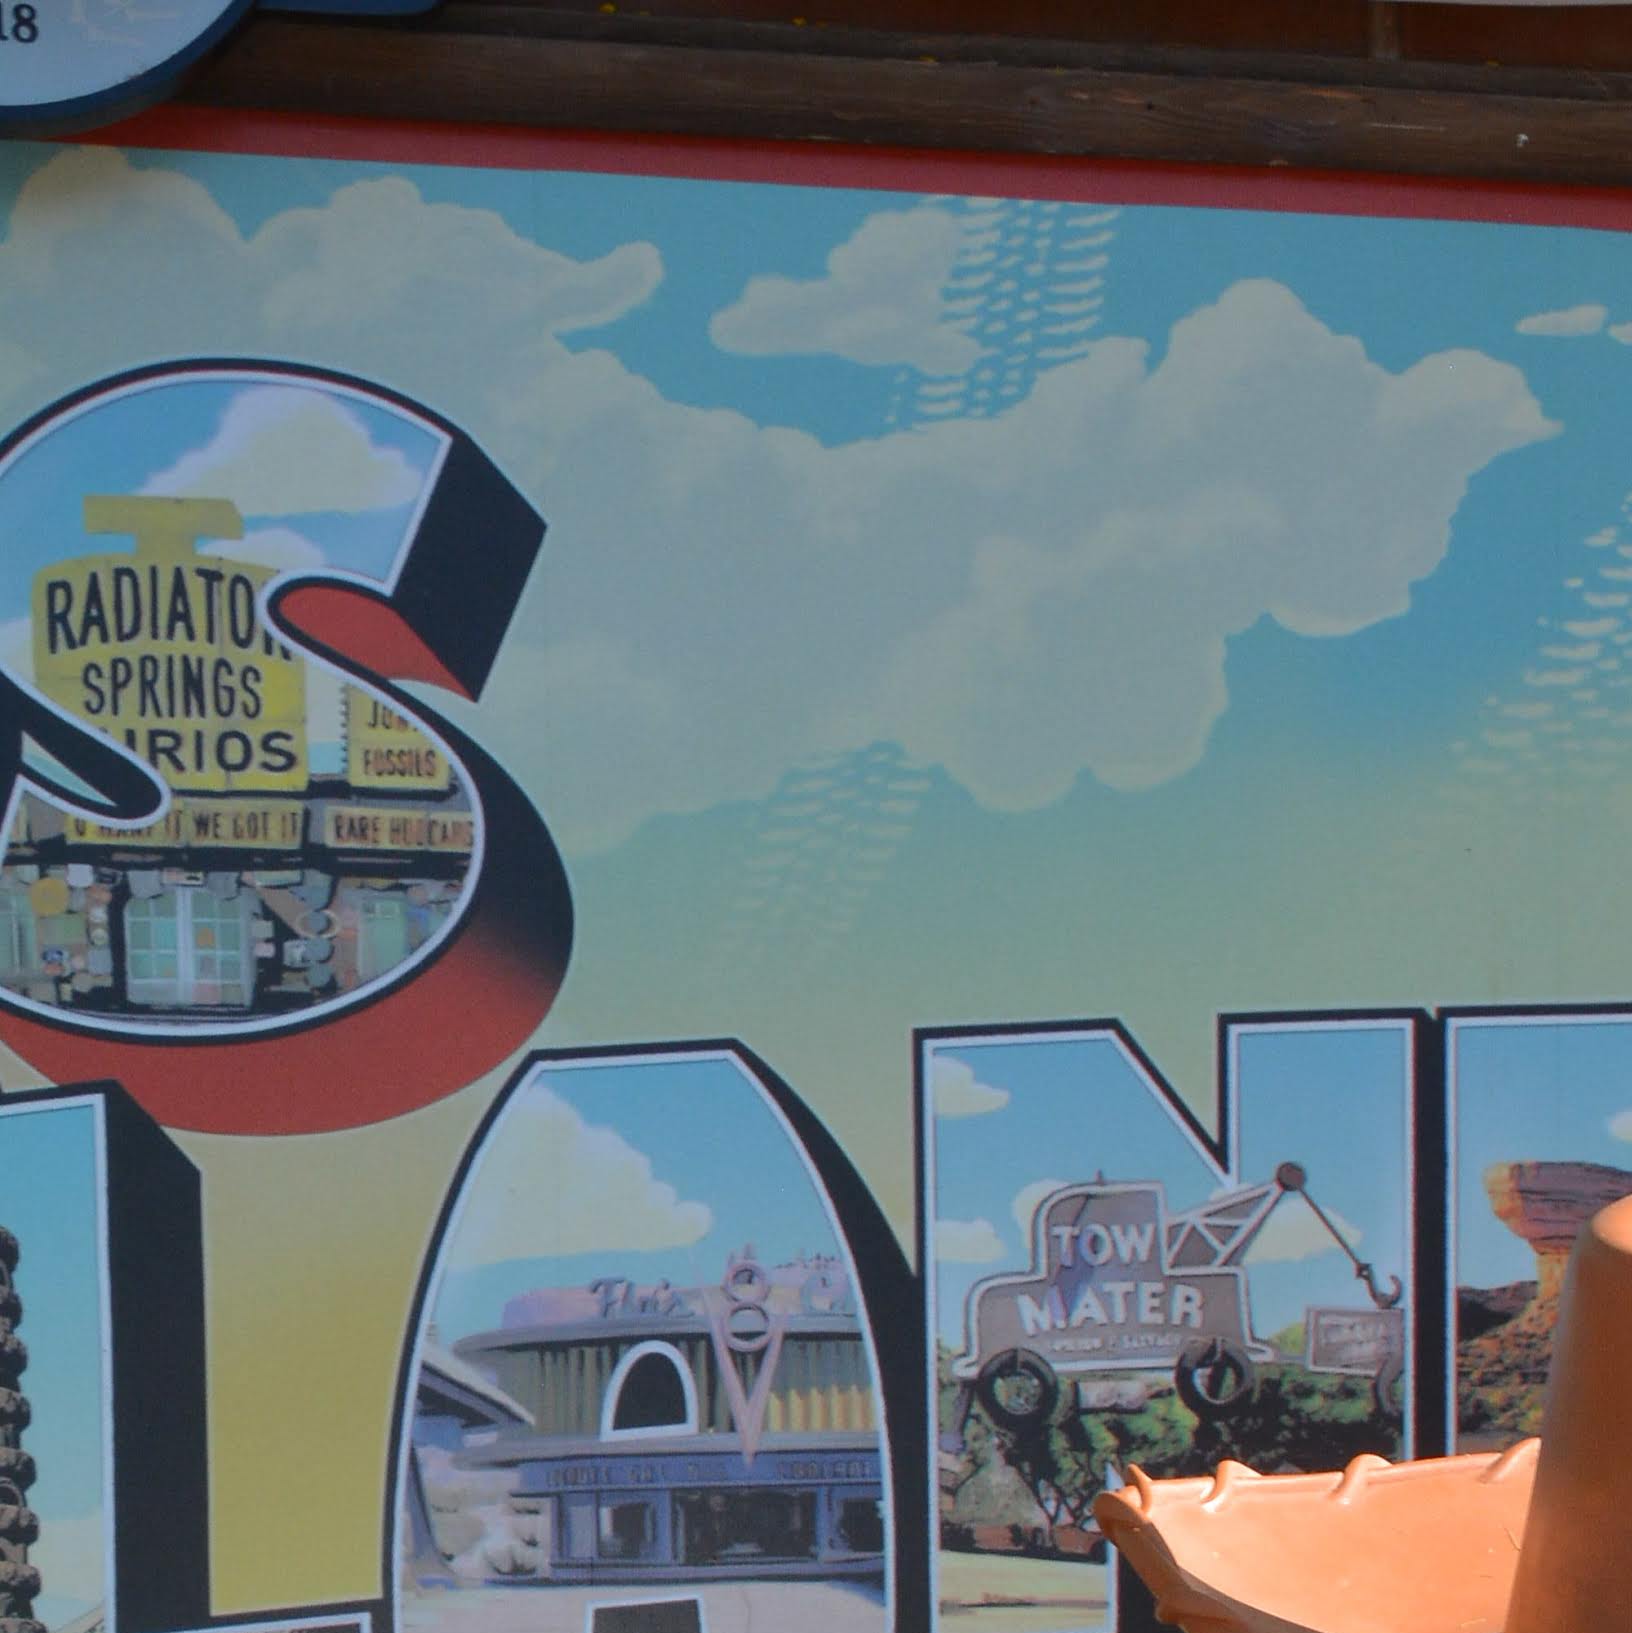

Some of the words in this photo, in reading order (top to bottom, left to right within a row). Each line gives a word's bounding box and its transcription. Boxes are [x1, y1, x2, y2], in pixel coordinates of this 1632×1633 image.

[82, 654, 262, 719] SPRINGS
[124, 728, 297, 774] RIOS
[194, 812, 221, 838] WE
[232, 811, 270, 840] GOT
[281, 811, 298, 839] IT
[1052, 1223, 1156, 1267] TOW
[1016, 1280, 1205, 1336] MATER
